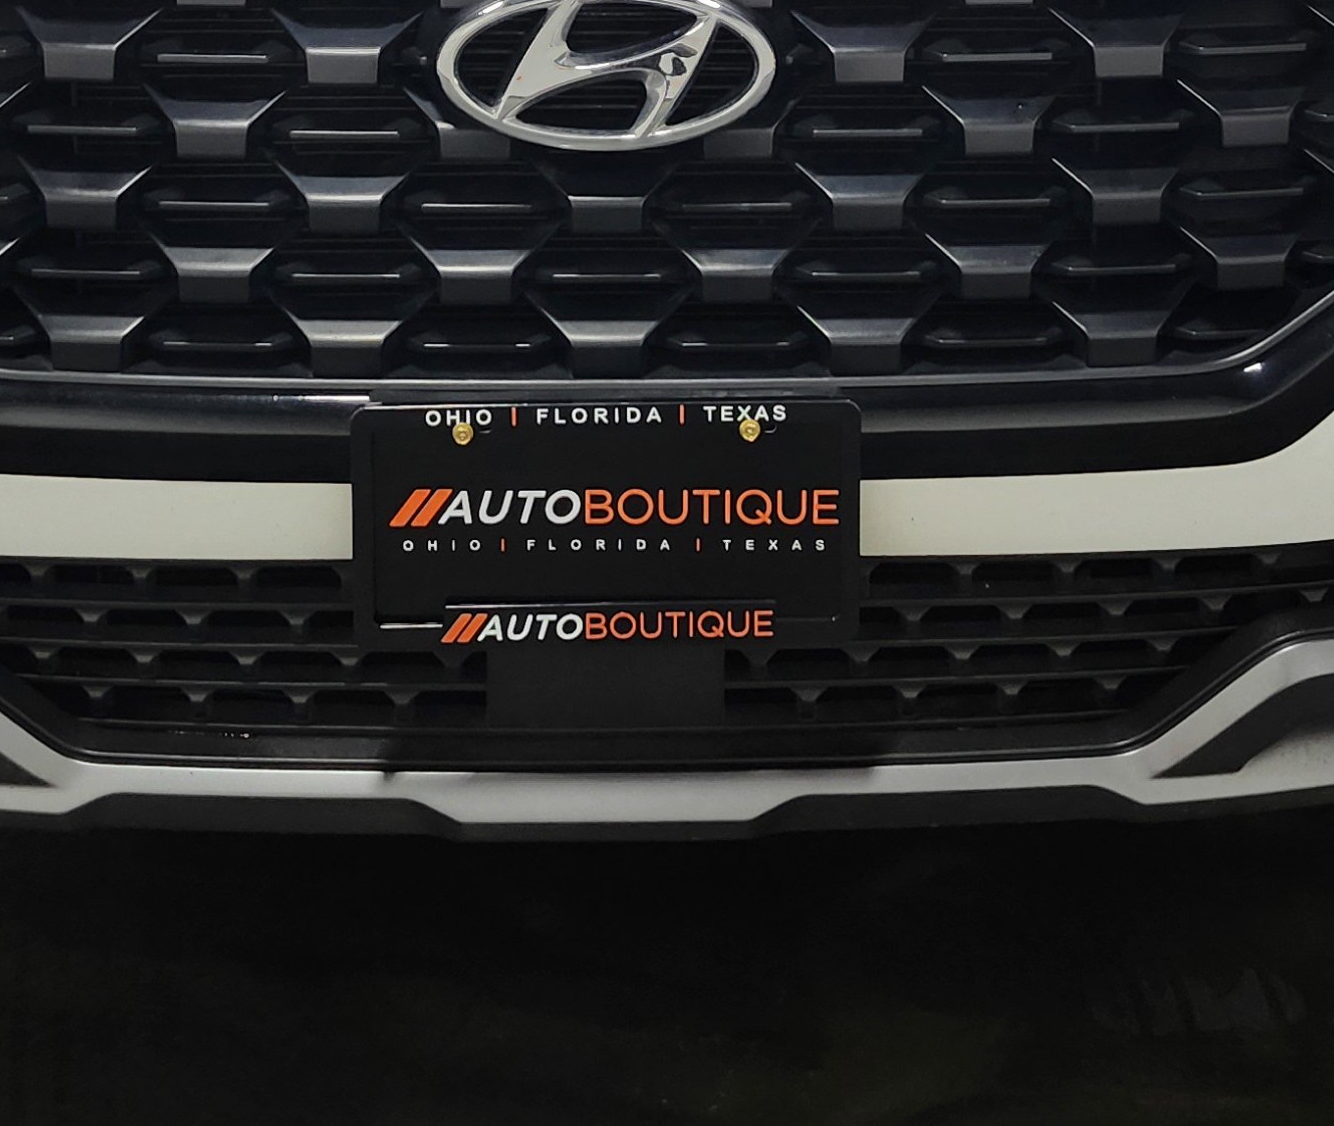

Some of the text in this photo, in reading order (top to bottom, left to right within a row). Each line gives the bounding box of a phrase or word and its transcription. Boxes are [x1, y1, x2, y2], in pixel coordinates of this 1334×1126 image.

[425, 404, 787, 427] OHIO FLORIDA TEXAS
[437, 488, 840, 525] AUTOBOUTIQUE
[402, 538, 826, 552] OHIO FLORIDA TEXAS
[476, 609, 774, 642] AUTOBOUTIQUE
